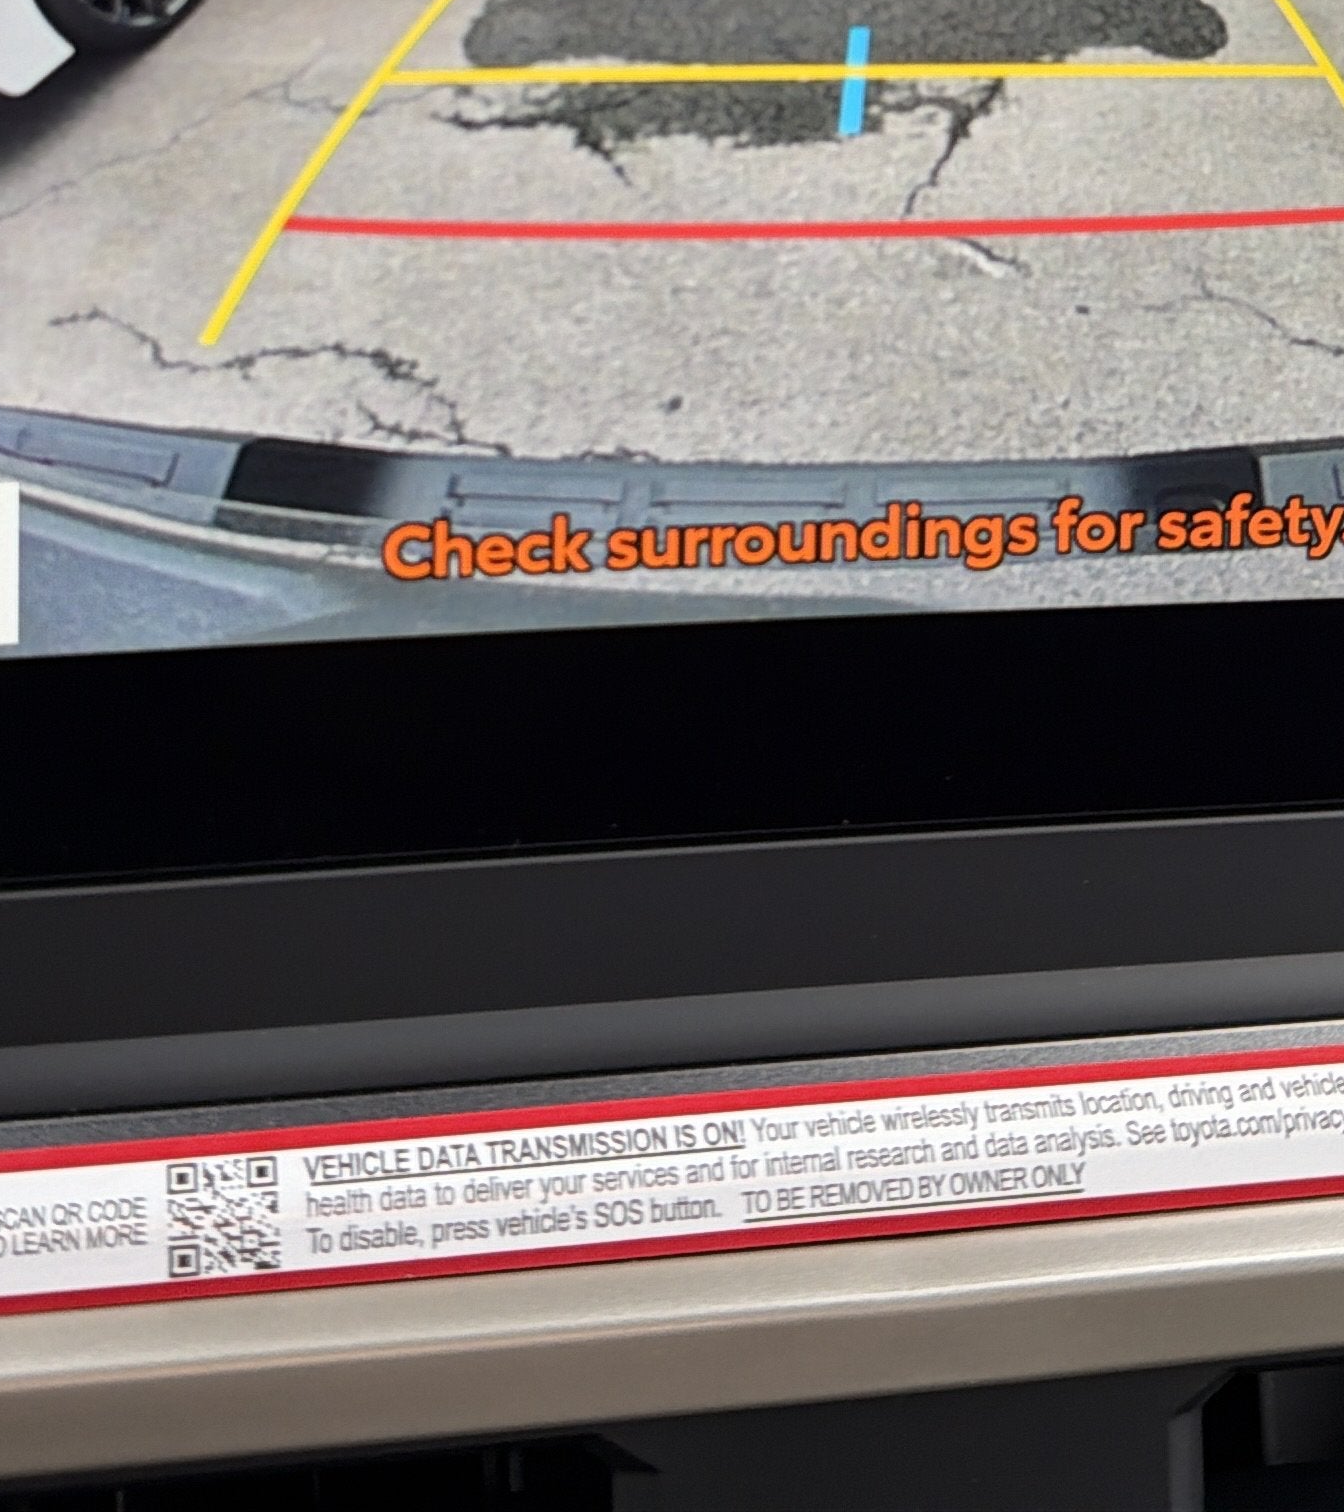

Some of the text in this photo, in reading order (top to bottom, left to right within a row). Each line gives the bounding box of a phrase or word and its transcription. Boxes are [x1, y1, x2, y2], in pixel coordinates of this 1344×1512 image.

[381, 510, 593, 581] Check
[605, 500, 1040, 571] surroundings
[1052, 493, 1146, 556] for
[303, 1148, 410, 1180] VEHICLE
[418, 1142, 482, 1170] DATA
[484, 1125, 667, 1165] TRANSMISSION
[674, 1124, 697, 1149] IS
[703, 1119, 746, 1146] ON!
[751, 1116, 799, 1142] Your
[805, 1109, 877, 1137] vehicle
[880, 1100, 979, 1131] wirelessly
[984, 1093, 1076, 1124] transmits
[1078, 1087, 1164, 1115] location,
[1168, 1081, 1235, 1109] driving
[1238, 1076, 1277, 1103] and
[306, 1187, 372, 1217] health
[379, 1184, 426, 1211] data
[434, 1181, 455, 1206] to
[463, 1175, 533, 1204] deliver
[539, 1173, 587, 1204] your
[592, 1163, 679, 1192] services
[686, 1156, 725, 1184] and
[730, 1154, 759, 1180] for
[764, 1145, 841, 1177] internal
[847, 1138, 935, 1170] research
[941, 1134, 979, 1162] and
[985, 1132, 1029, 1158] data
[1034, 1123, 1122, 1157] analysis.
[1126, 1120, 1168, 1146] See
[12, 1228, 80, 1256] LEARN
[86, 1222, 148, 1249] MORE
[52, 1203, 83, 1226] QR
[88, 1197, 147, 1223] CODE
[306, 1161, 1086, 1254] To disable, press vehicle's SOS button. TO BE REMOVED BY OWNER ONLY
